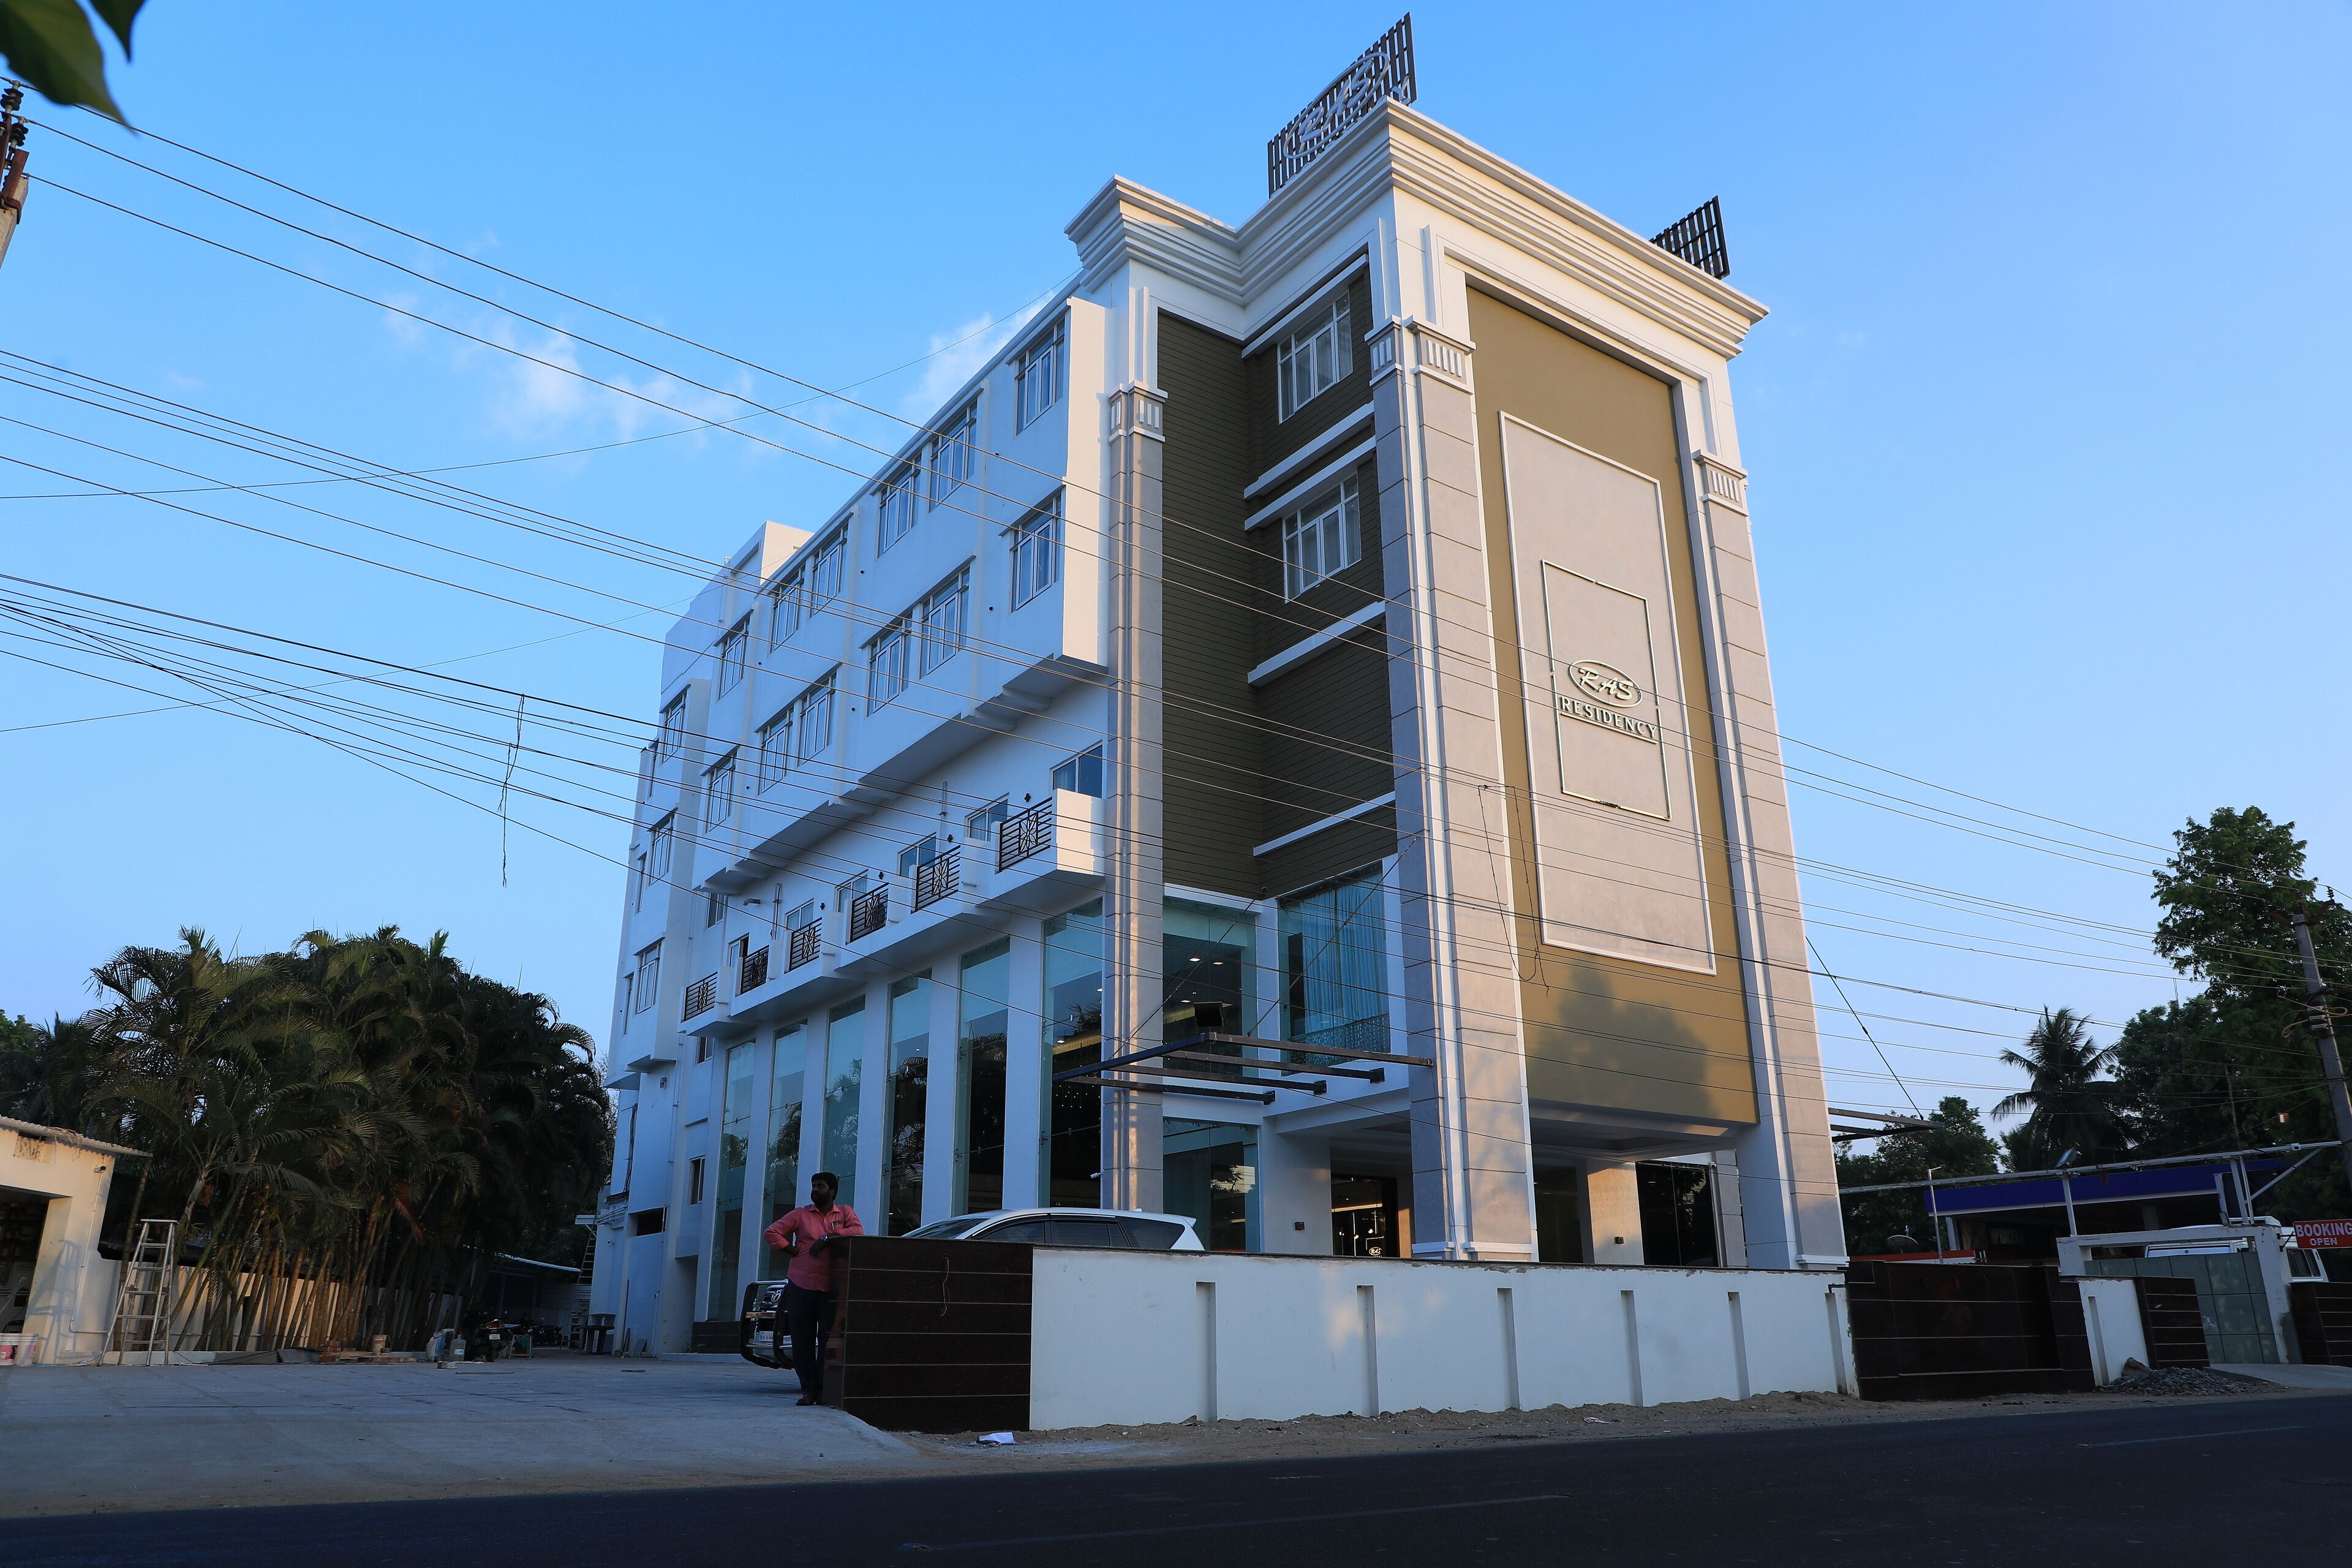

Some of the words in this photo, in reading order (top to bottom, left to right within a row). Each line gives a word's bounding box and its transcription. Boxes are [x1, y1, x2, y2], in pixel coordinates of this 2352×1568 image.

[1298, 58, 1374, 153] RAS
[1578, 666, 1635, 700] RAS
[1561, 695, 1658, 739] RESIDENCY
[2295, 1222, 2352, 1237] BOOKING
[2310, 1237, 2338, 1246] OPEN
